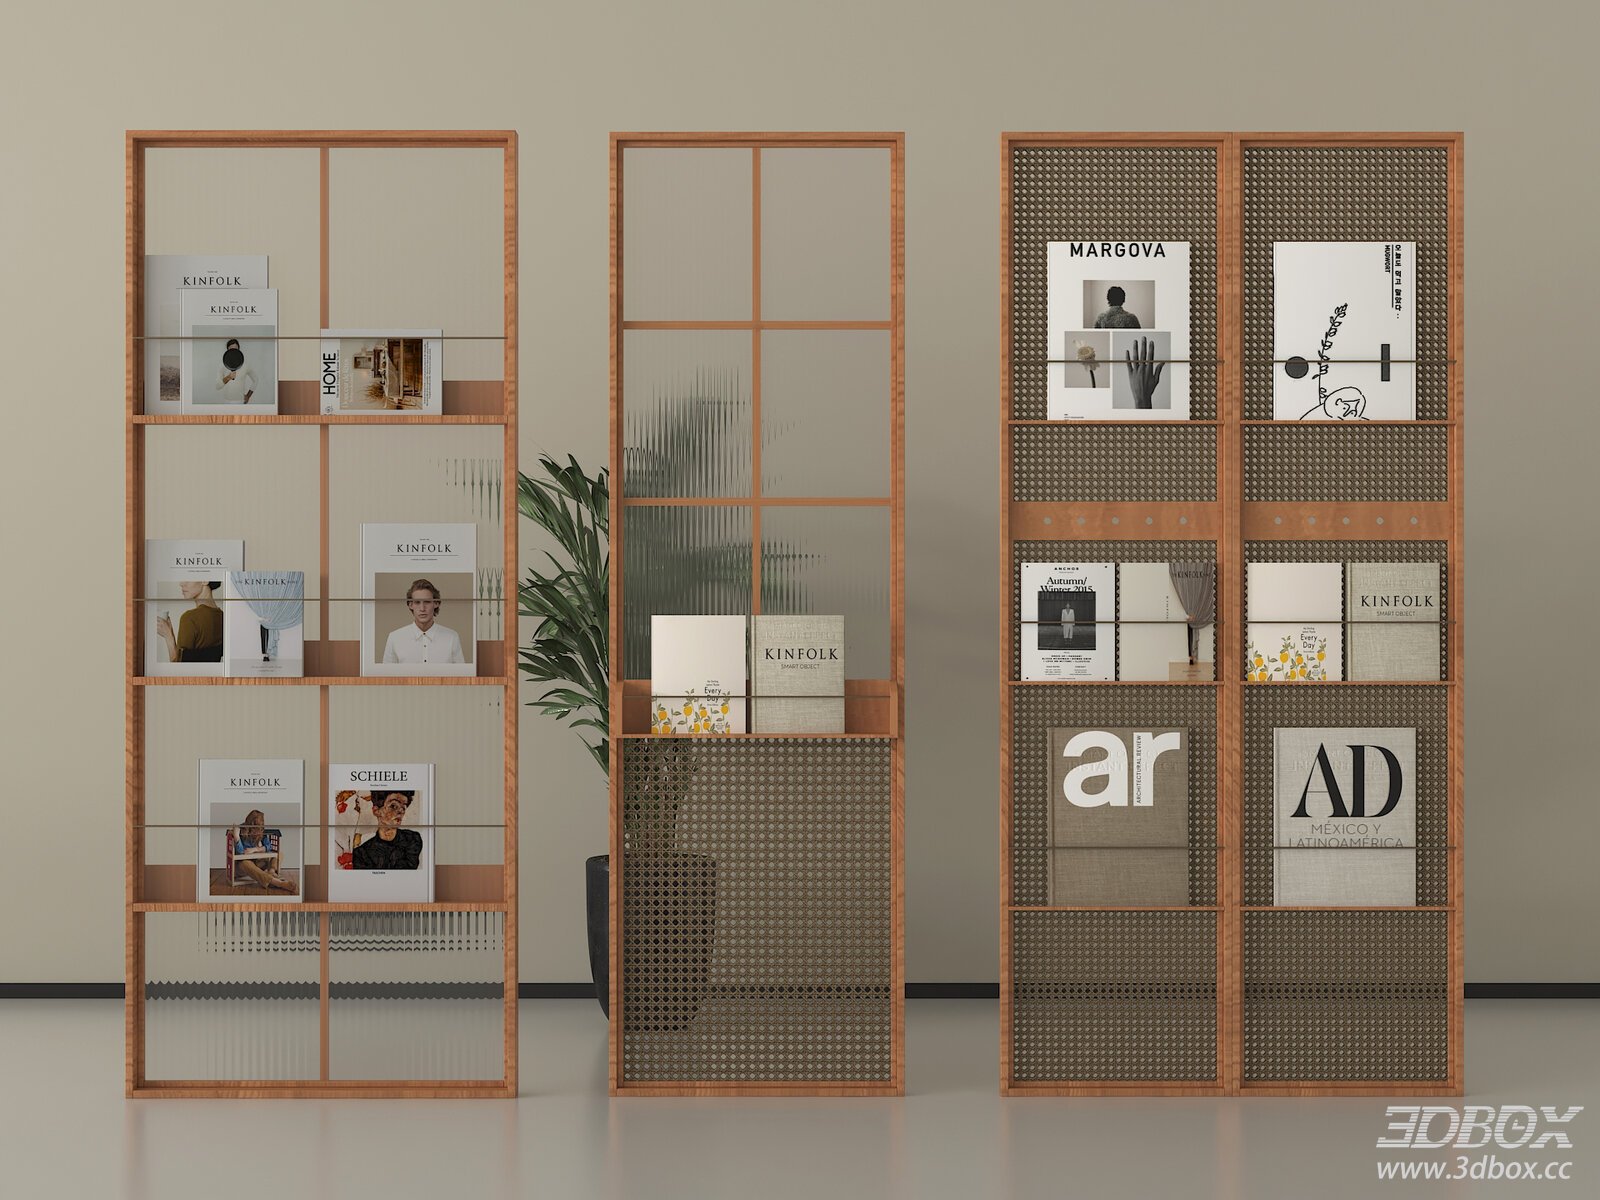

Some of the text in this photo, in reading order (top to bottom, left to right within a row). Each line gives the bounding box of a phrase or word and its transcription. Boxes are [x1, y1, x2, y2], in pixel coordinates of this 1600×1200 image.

[1070, 242, 1166, 258] MARGOVA
[183, 276, 242, 286] KINFOLK
[210, 305, 257, 314] KINFOLK
[322, 352, 337, 395] HOME
[397, 543, 452, 553] KINFOLK
[175, 557, 222, 566] KINFOLK
[244, 578, 288, 586] KINFOLK
[1046, 576, 1088, 586] Autumn/
[1361, 595, 1434, 608] KINFOLK
[1300, 633, 1318, 643] Every
[1302, 641, 1316, 650] Day
[765, 648, 839, 660] KINFOLK
[704, 686, 722, 696] Every
[1063, 730, 1181, 808] ar
[350, 770, 408, 782] SCHIELE
[1290, 741, 1404, 818] AD
[230, 778, 281, 787] KINFOLK
[1311, 820, 1382, 835] MÉXICO Y
[1289, 834, 1404, 848] LATINOAMÉRICA
